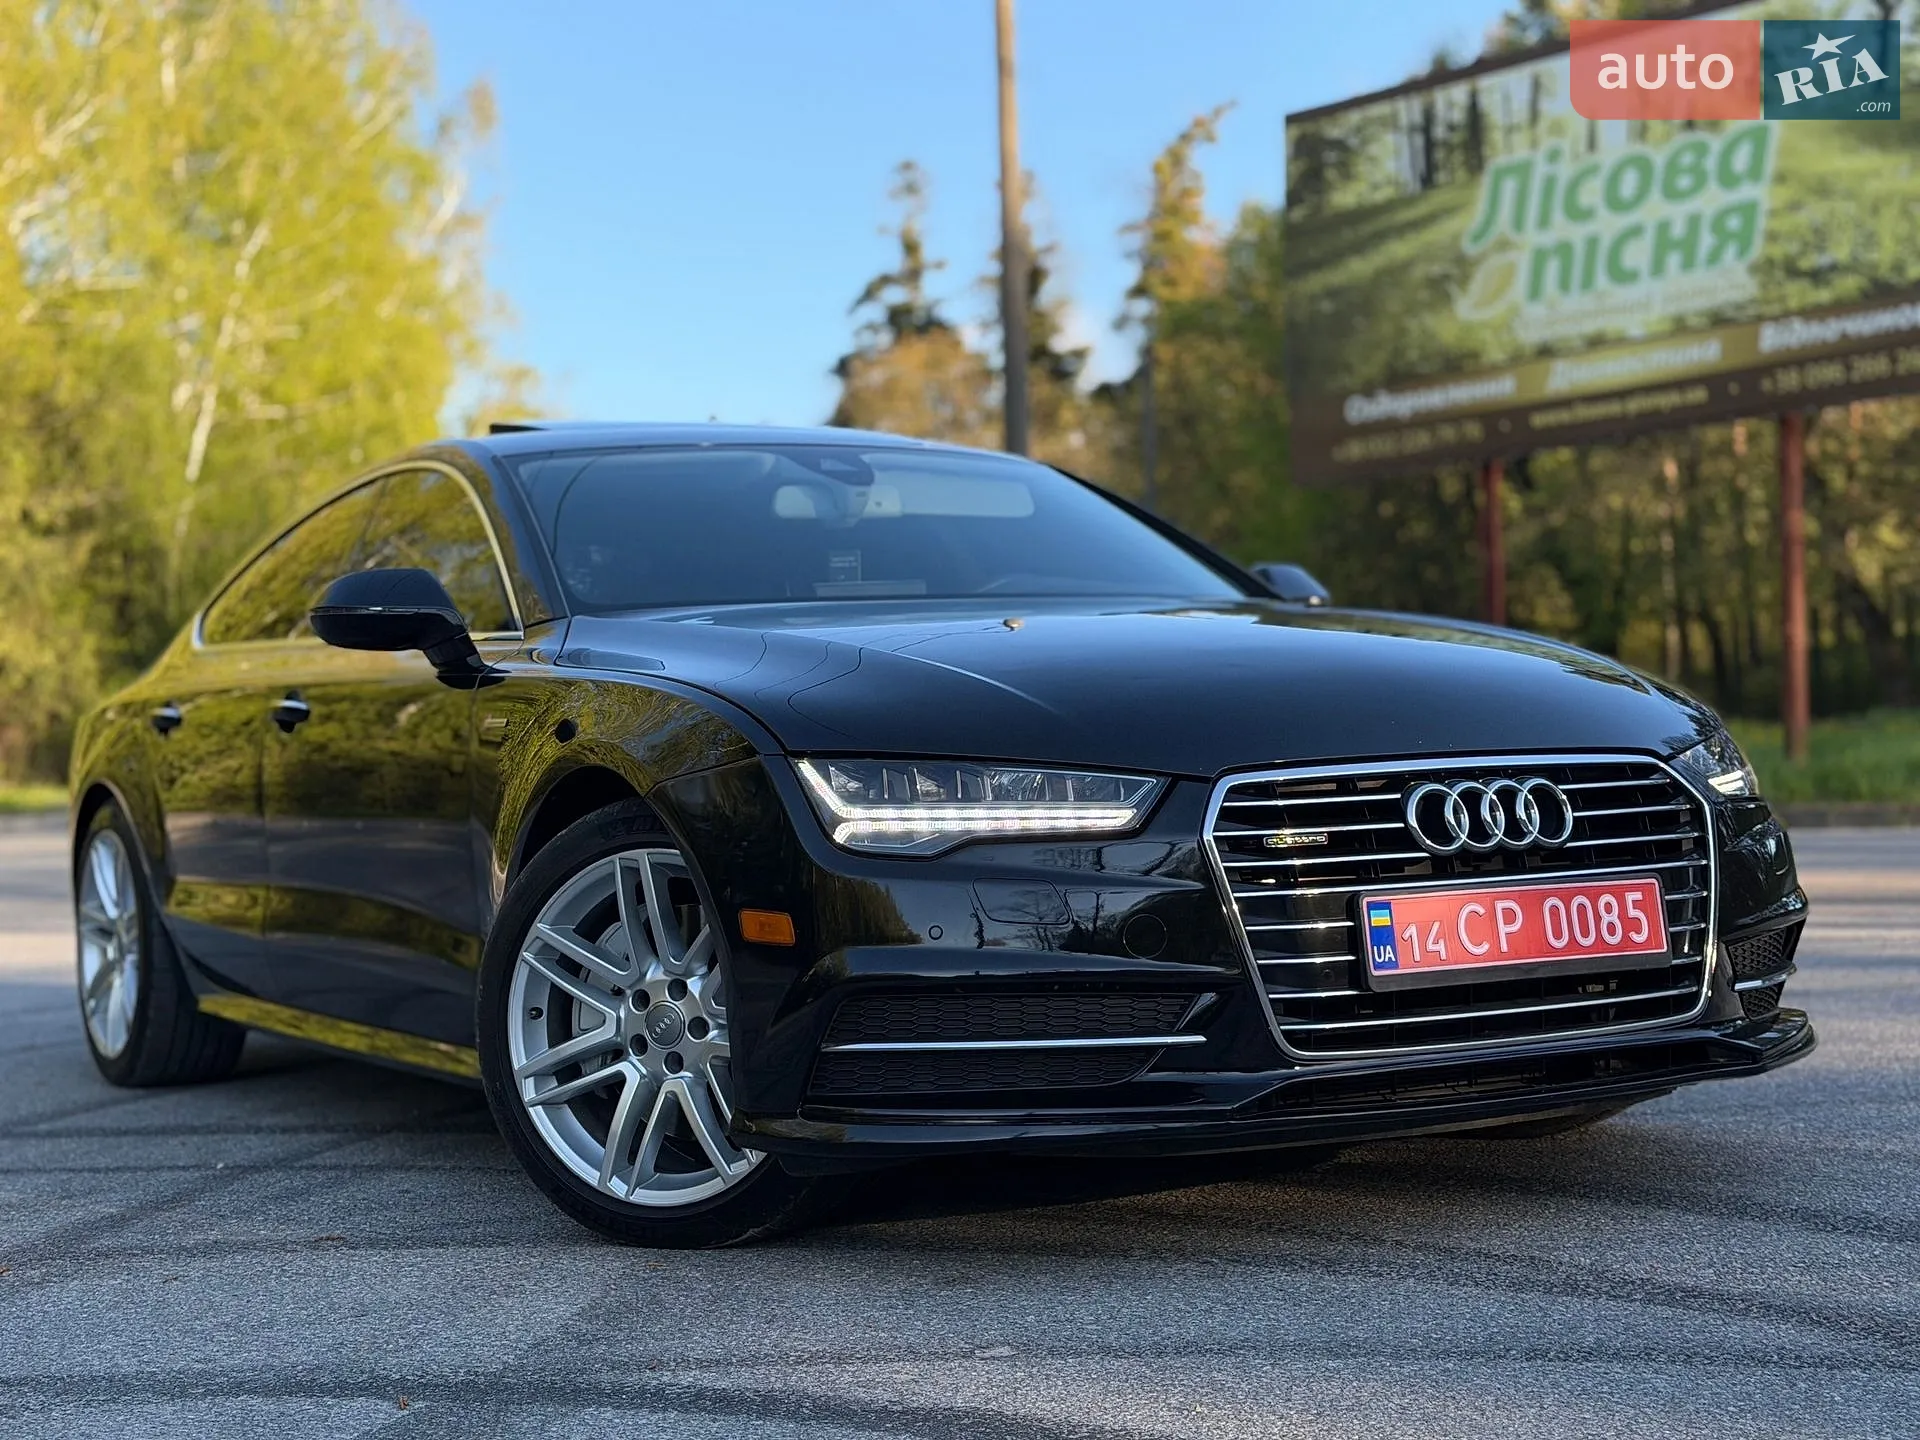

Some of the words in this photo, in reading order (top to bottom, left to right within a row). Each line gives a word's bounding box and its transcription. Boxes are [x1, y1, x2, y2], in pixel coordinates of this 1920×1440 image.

[1401, 921, 1448, 962] 14
[1457, 900, 1524, 956] CP
[1542, 891, 1649, 949] 0085
[1373, 945, 1396, 963] UA
